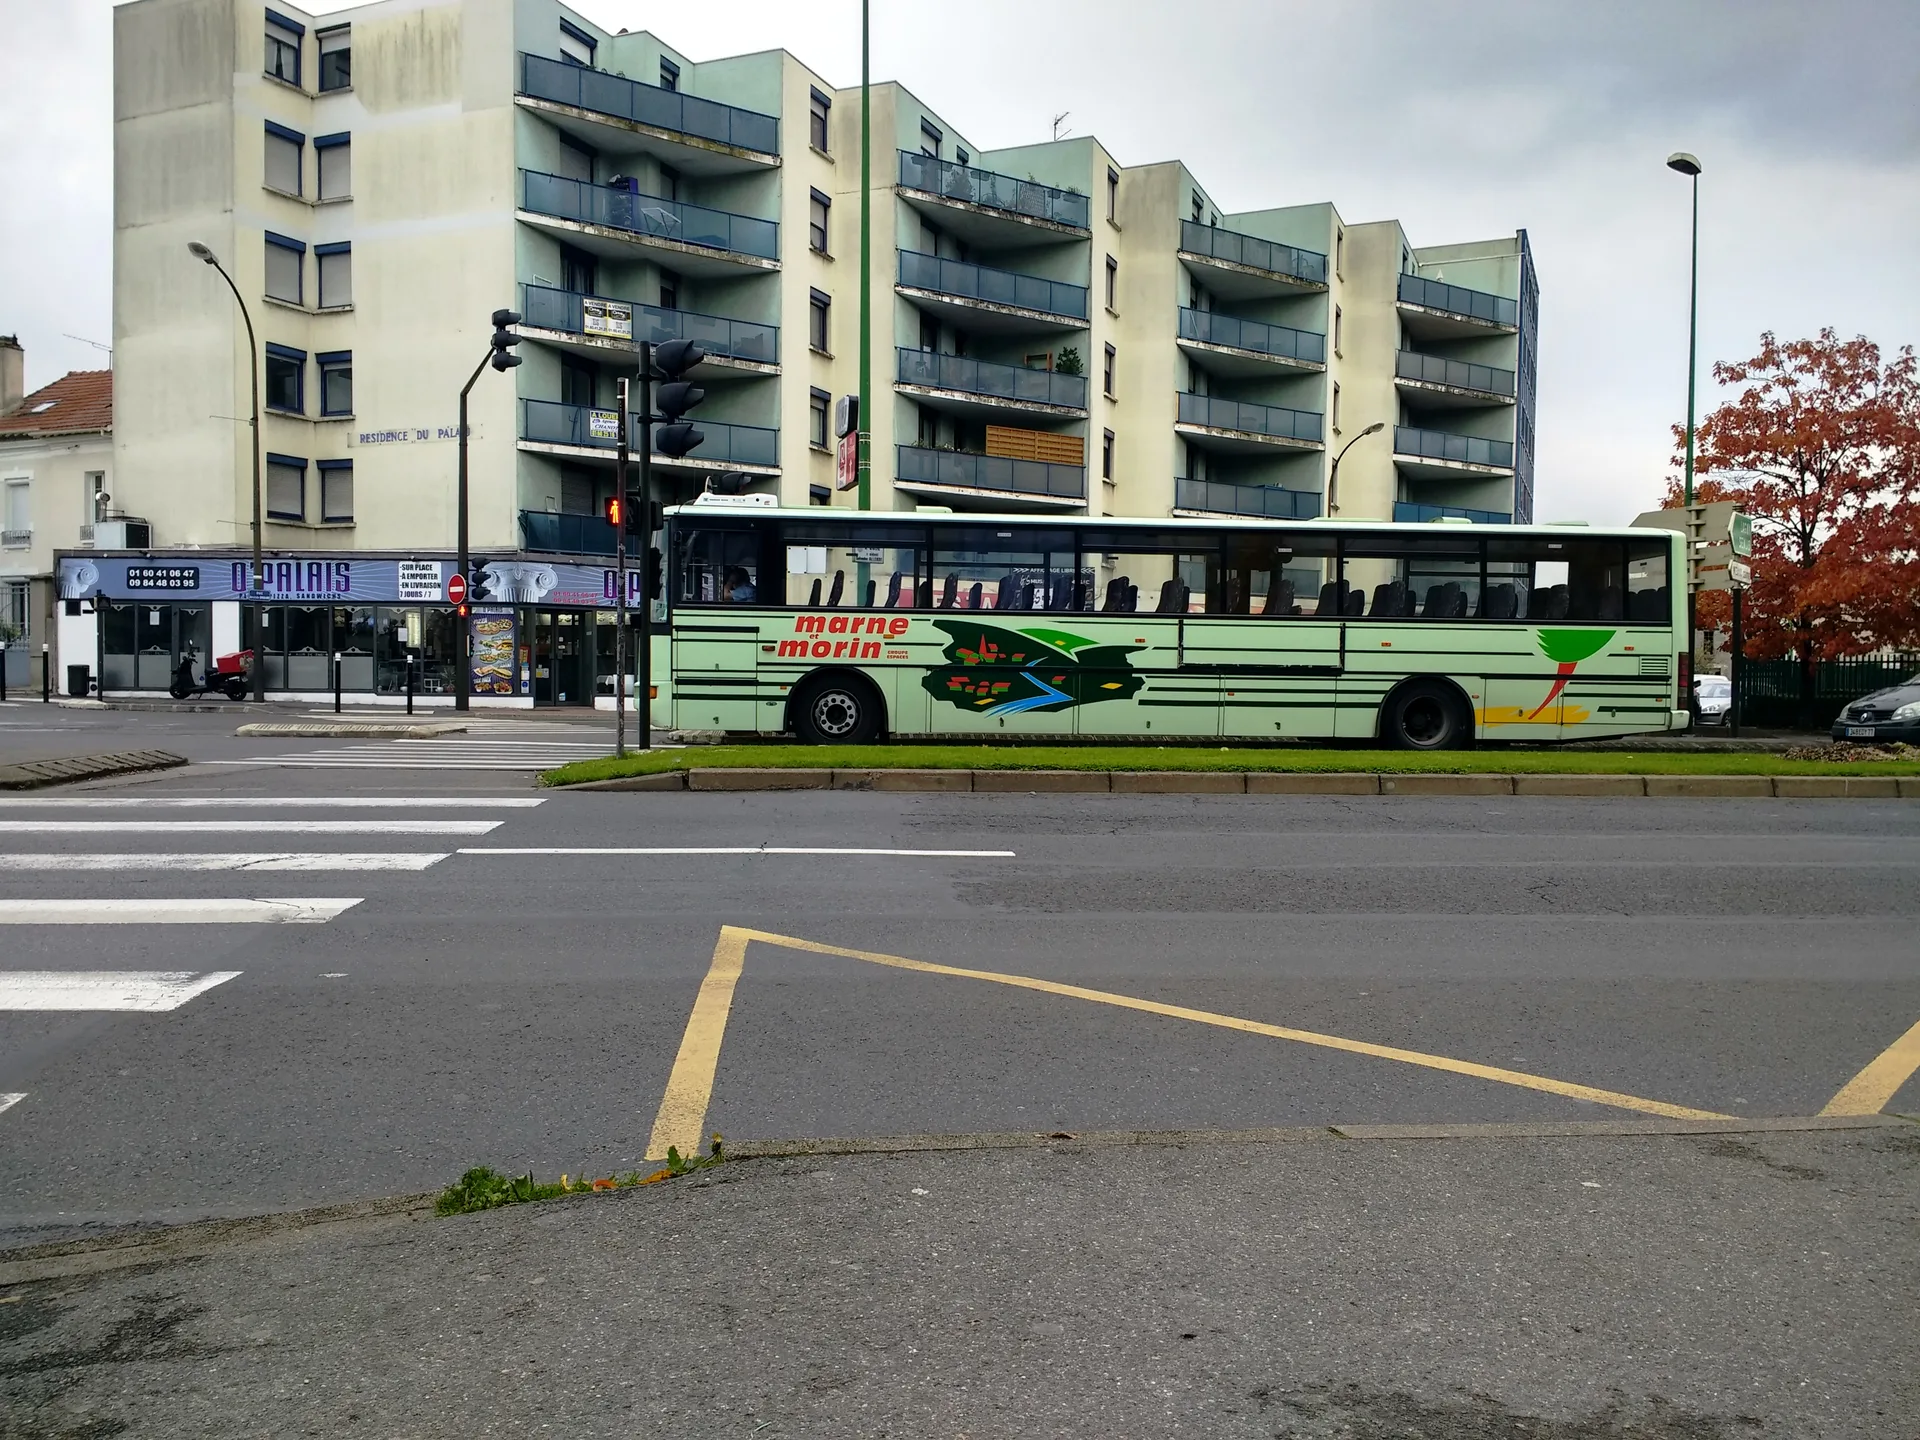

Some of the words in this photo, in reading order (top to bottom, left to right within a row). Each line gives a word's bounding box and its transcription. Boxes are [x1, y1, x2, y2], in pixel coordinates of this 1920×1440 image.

[360, 431, 408, 444] RESIDENCE
[416, 429, 429, 440] DU
[437, 427, 470, 439] PALA
[129, 569, 140, 577] 01
[143, 569, 154, 577] 60
[156, 569, 167, 577] 41
[169, 569, 181, 577] 06
[183, 569, 194, 577] 47
[129, 579, 140, 587] 09
[143, 579, 154, 587] 84
[156, 579, 167, 587] 48
[169, 579, 181, 587] 03
[183, 579, 194, 587] 95
[795, 615, 909, 635] marne
[777, 638, 882, 658] morin
